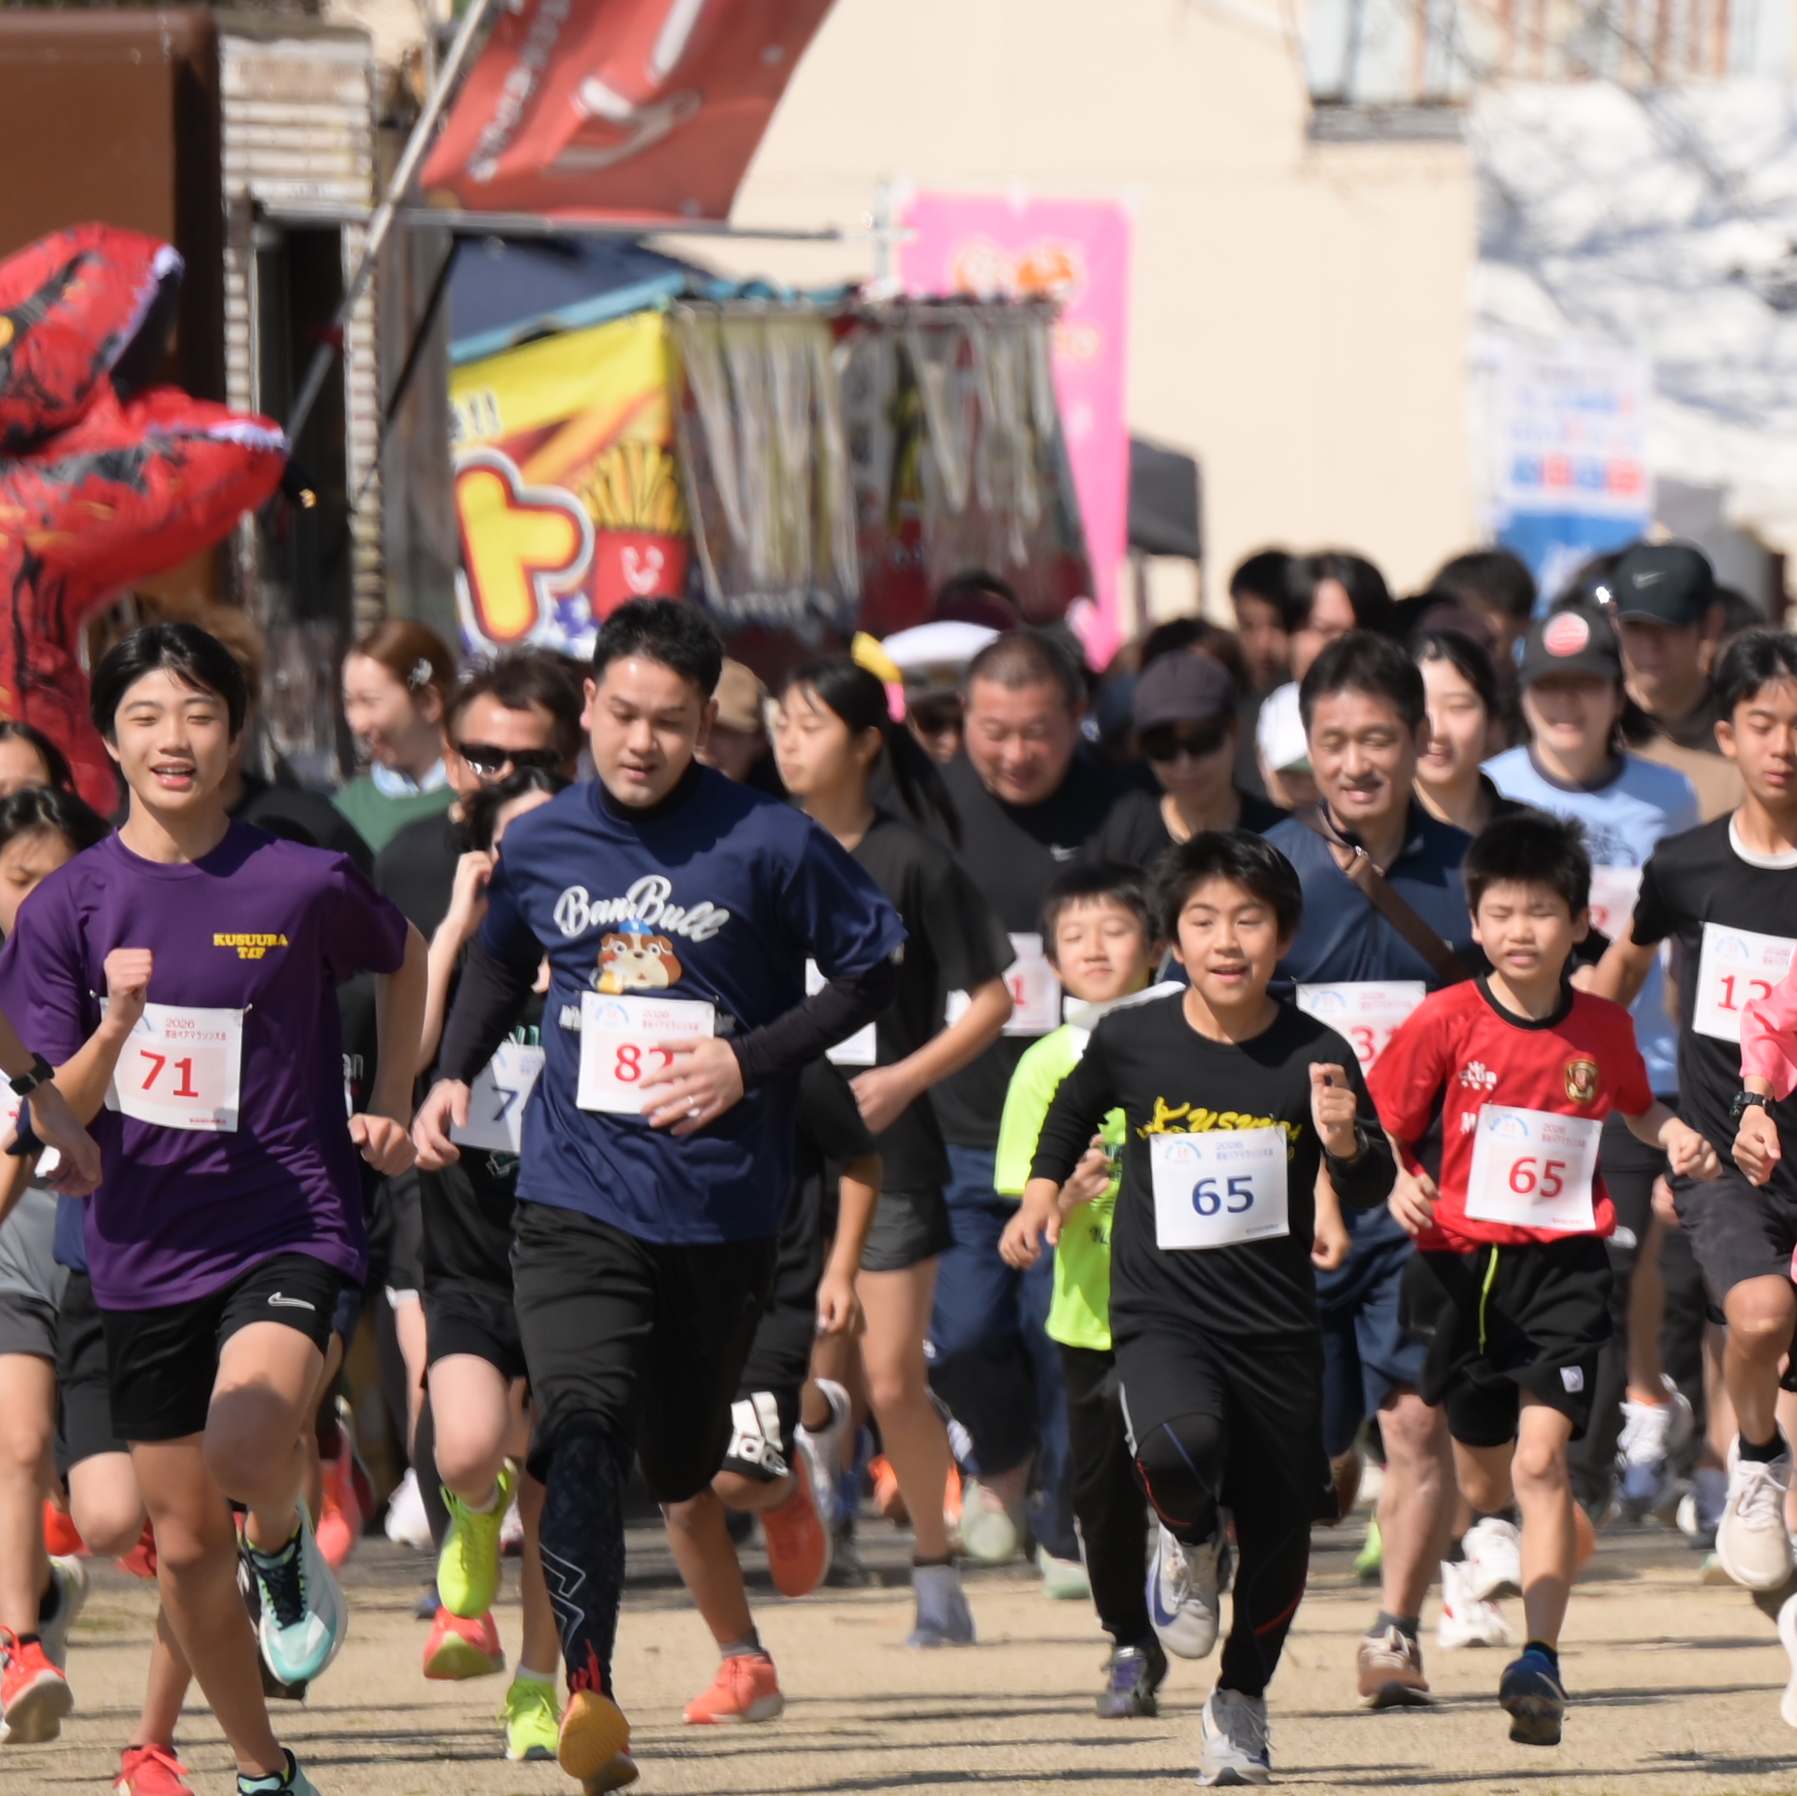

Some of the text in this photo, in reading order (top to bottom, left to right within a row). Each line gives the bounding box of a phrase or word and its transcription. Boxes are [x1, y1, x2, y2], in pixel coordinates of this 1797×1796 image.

[213, 933, 289, 947] KUSUURA
[166, 1018, 196, 1029] 2026
[140, 1050, 199, 1098] 71
[1192, 1175, 1255, 1216] 65
[1508, 1156, 1566, 1199] 65
